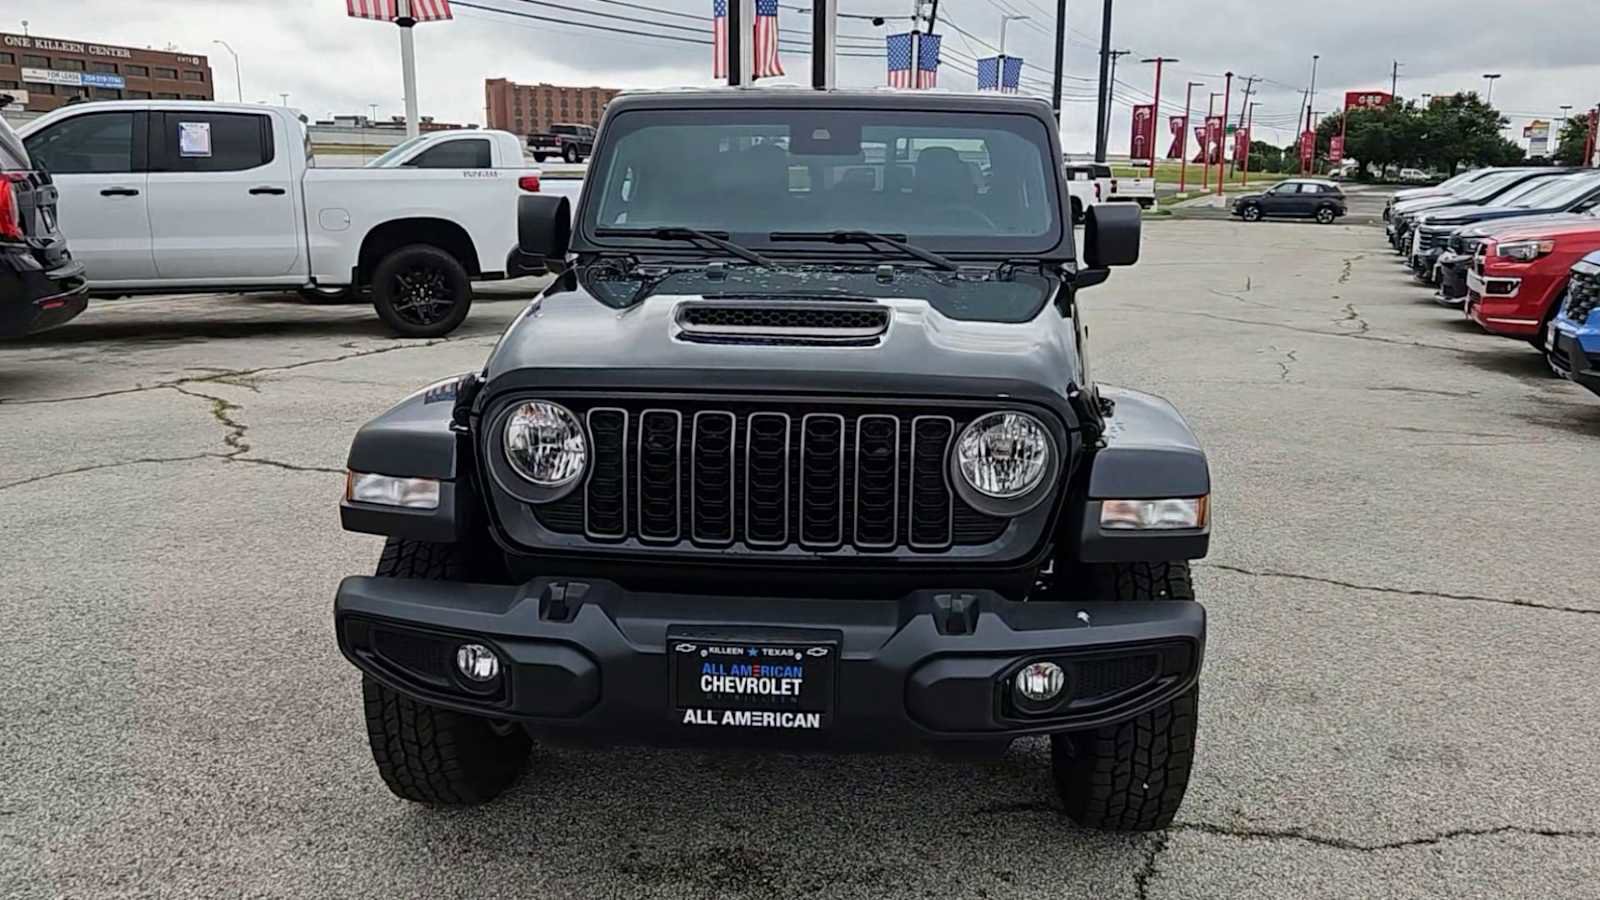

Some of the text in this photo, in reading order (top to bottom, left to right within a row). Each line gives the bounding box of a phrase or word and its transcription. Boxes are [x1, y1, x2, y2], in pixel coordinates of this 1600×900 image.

[4, 36, 131, 58] ONE KILLEEN CENTER
[709, 647, 795, 657] KILLEEN TEXAS
[702, 663, 802, 678] ALL AMERICAN
[701, 675, 803, 696] CHEVROLET
[683, 709, 819, 728] ALL AMERICAN
